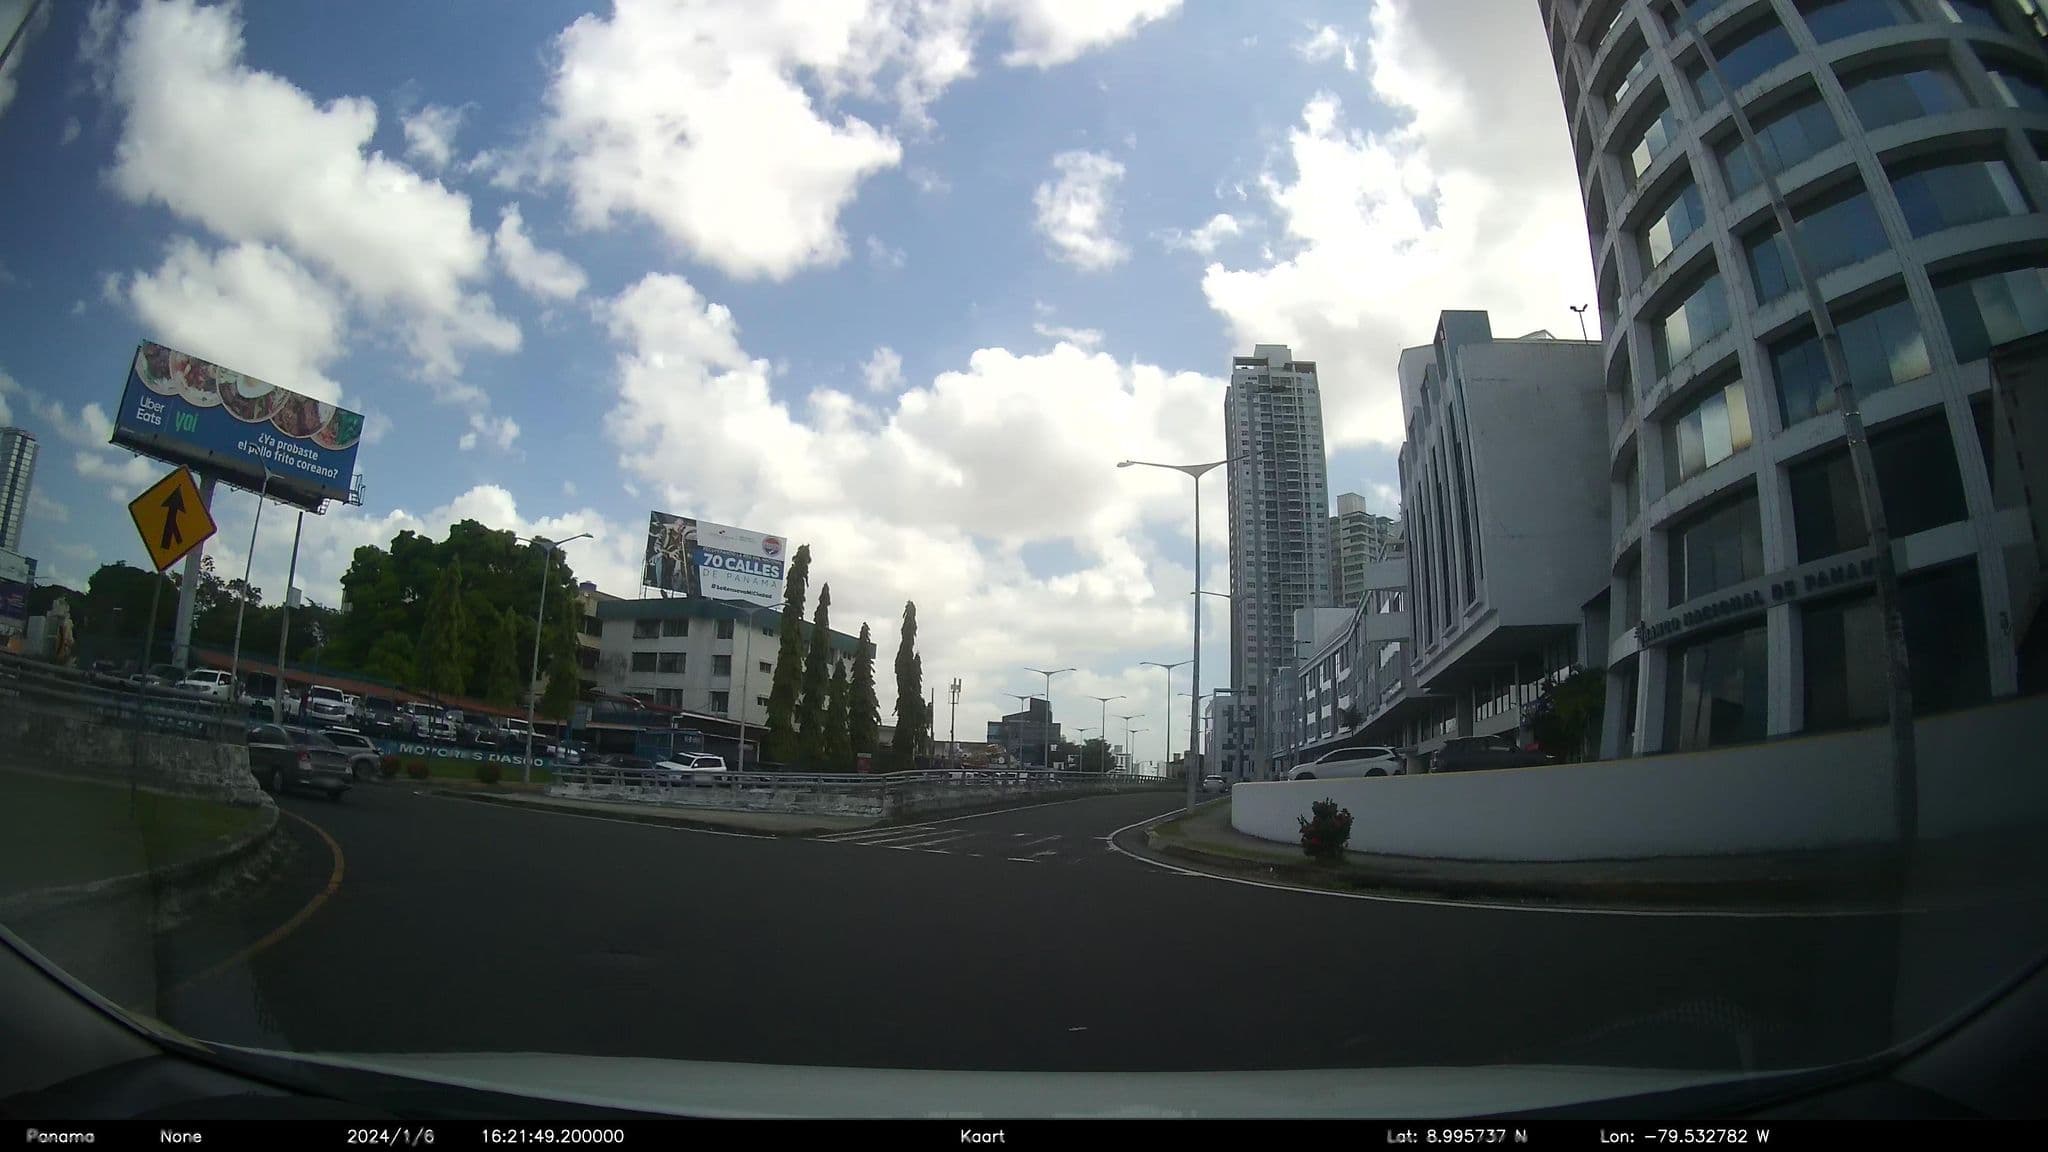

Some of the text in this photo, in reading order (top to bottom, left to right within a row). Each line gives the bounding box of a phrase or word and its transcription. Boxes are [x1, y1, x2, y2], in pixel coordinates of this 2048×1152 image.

[140, 396, 165, 413] Uber
[136, 408, 162, 425] Eats
[258, 432, 319, 461] ¿Ya probaste
[237, 440, 248, 451] el
[274, 450, 296, 465] frito
[296, 460, 339, 479] coreano?
[702, 568, 719, 578] DE
[703, 552, 723, 568] 70
[724, 557, 780, 578] CALLES
